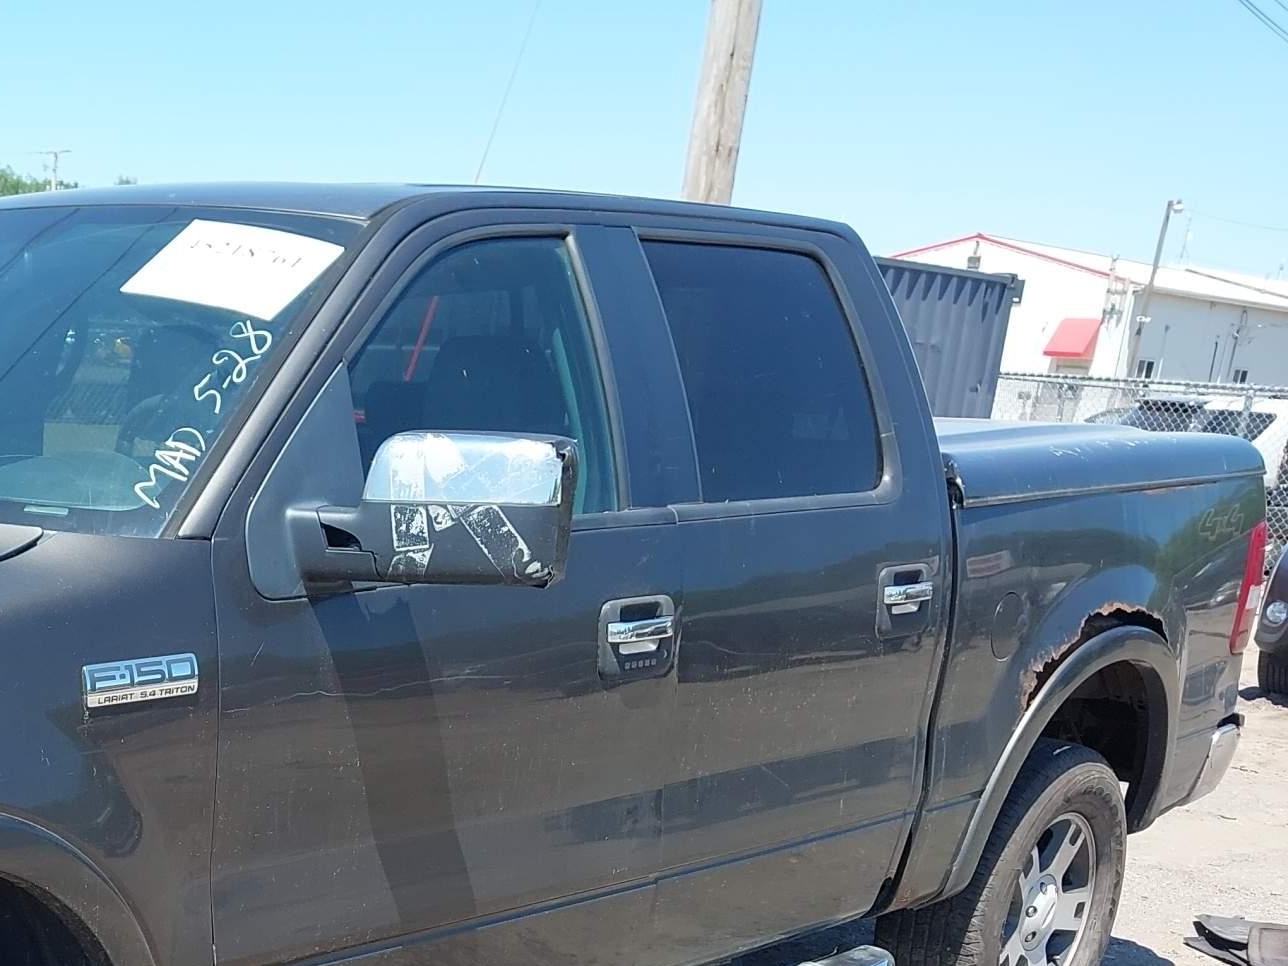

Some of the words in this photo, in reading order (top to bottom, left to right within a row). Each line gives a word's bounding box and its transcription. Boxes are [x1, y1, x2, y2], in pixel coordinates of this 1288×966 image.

[133, 427, 206, 510] MAD
[193, 319, 273, 414] 5-28
[87, 656, 196, 692] F-150
[97, 692, 135, 705] LARIAT
[139, 689, 157, 699] 5.4
[159, 684, 196, 697] TRITON
